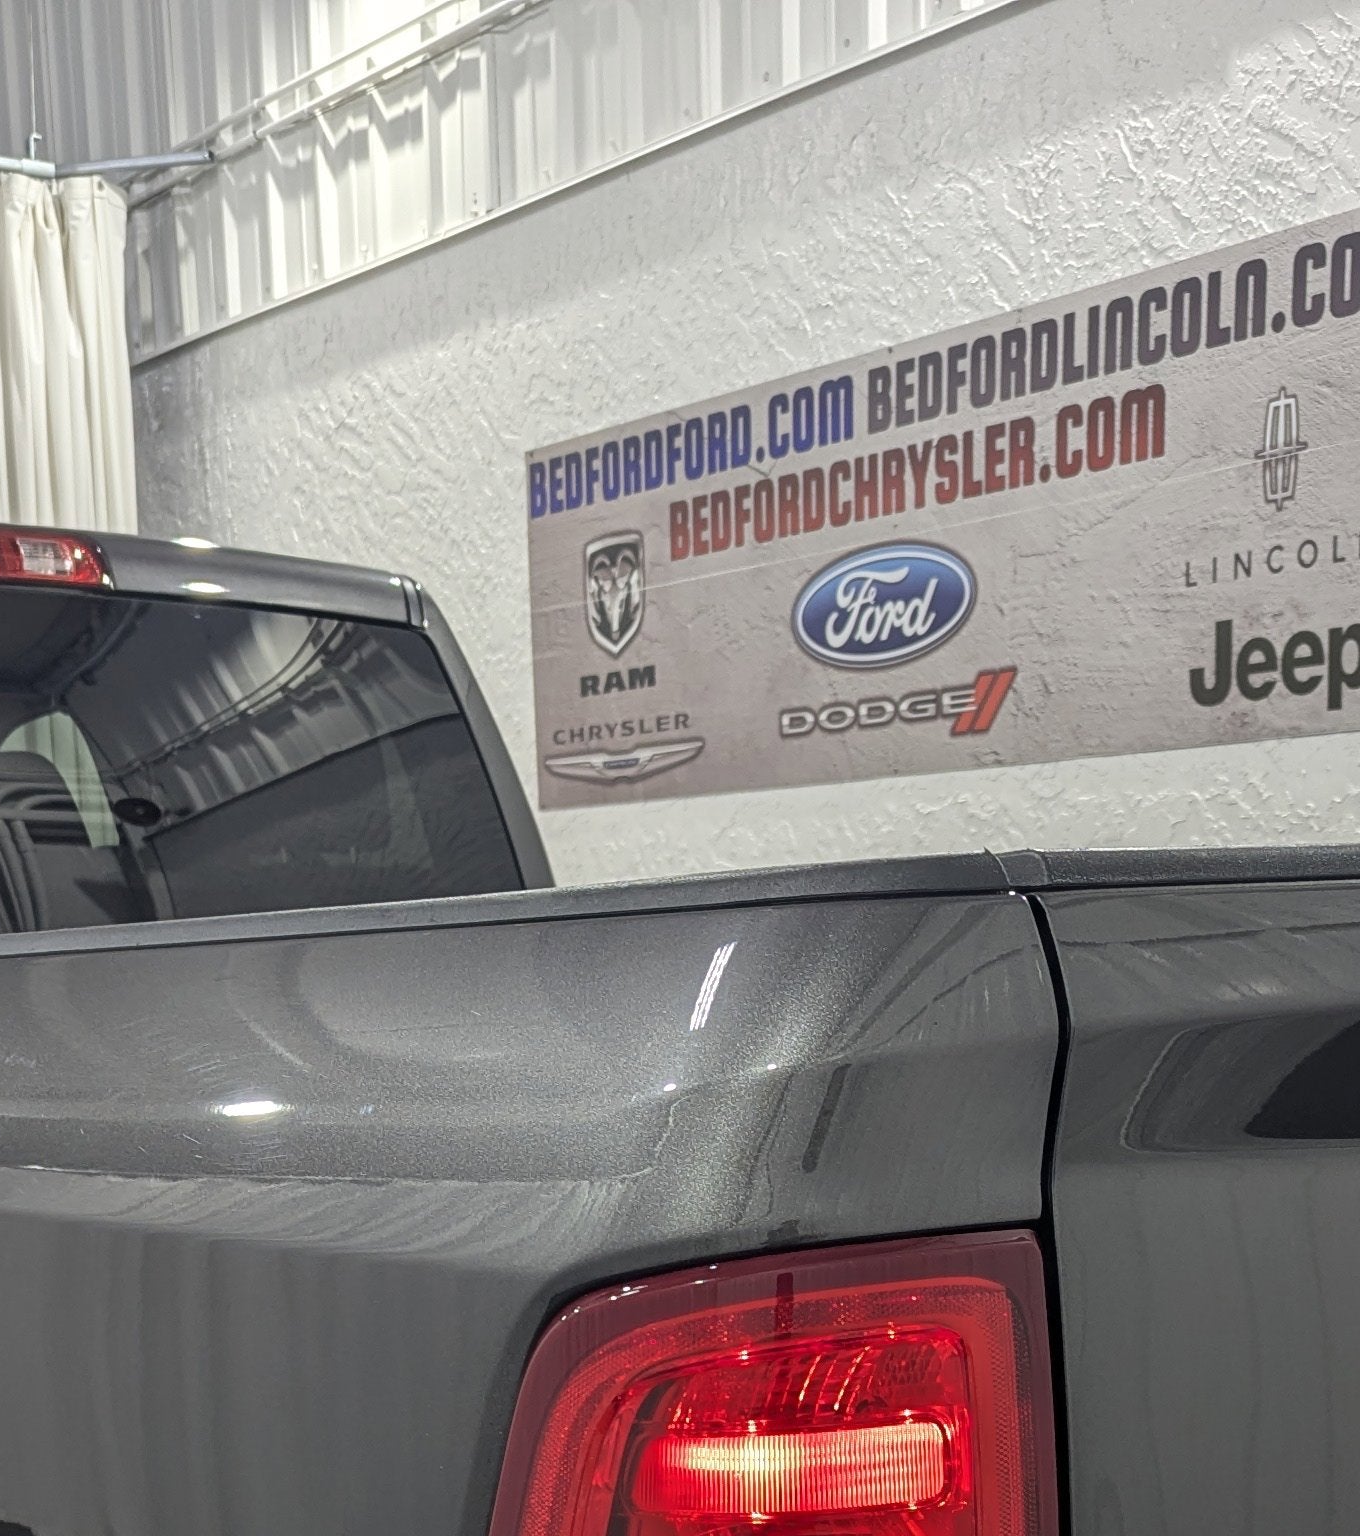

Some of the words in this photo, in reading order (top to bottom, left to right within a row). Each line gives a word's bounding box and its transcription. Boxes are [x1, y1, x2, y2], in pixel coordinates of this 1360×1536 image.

[529, 374, 855, 520] BEDFORDFORD.COM
[668, 383, 1166, 562] BEDFORDCHRYSLER.COM
[824, 566, 938, 646] Ford
[580, 665, 657, 698] RAM
[779, 688, 978, 739] DODGE
[553, 713, 691, 746] CHRYSLER
